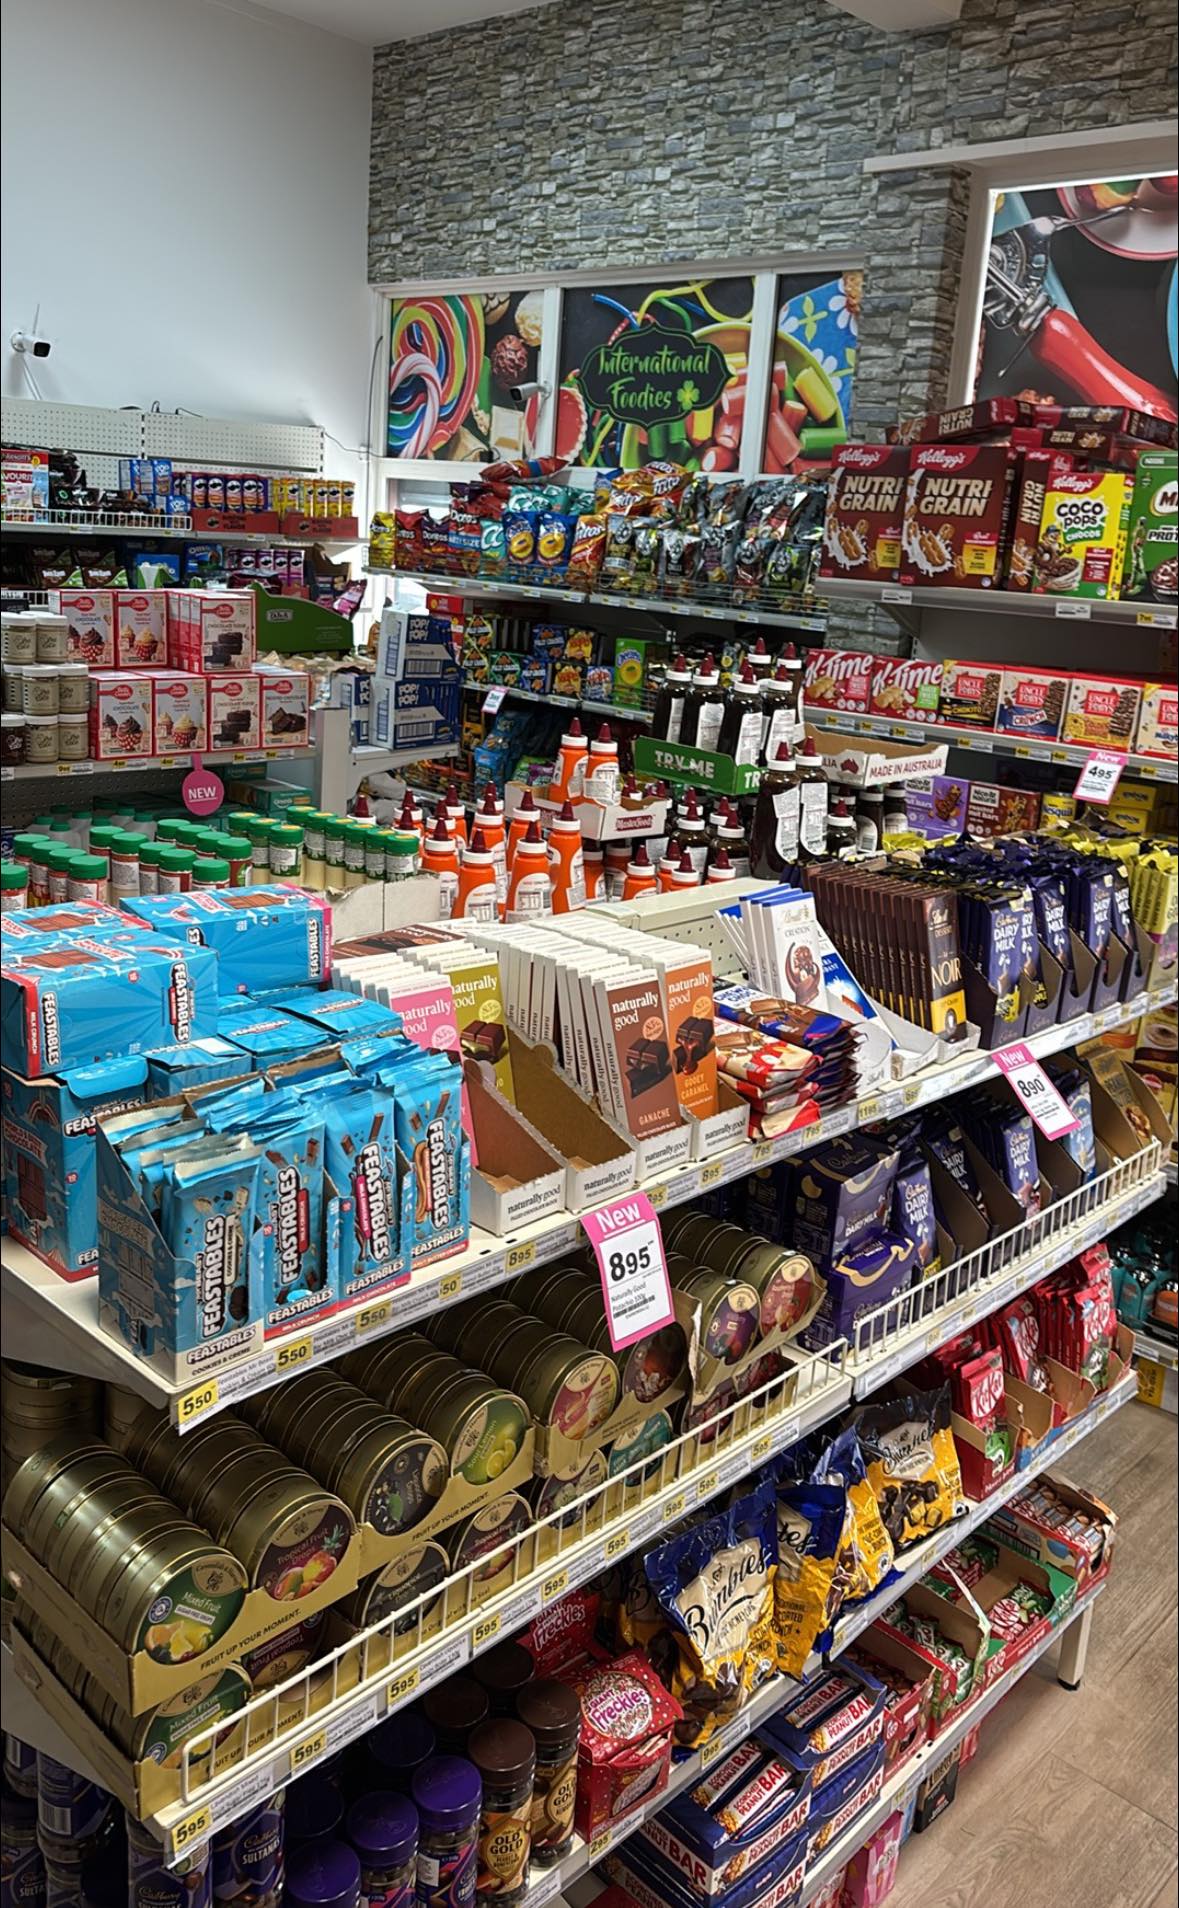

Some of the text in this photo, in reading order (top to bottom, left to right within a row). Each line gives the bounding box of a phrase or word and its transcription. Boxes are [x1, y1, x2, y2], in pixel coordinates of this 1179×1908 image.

[599, 345, 711, 375] International
[606, 377, 671, 411] Foodies
[839, 448, 880, 466] Kellogg's
[917, 449, 965, 468] Kellogg's
[1053, 475, 1094, 492] Kellogg's
[840, 494, 900, 512] GRAIN
[920, 497, 987, 516] GRAIN
[1057, 501, 1104, 517] COCO
[1064, 515, 1097, 529] pops
[806, 651, 873, 688] K-Time
[873, 659, 944, 696] K-Time
[958, 678, 981, 689] UNCLE
[1019, 686, 1044, 697] UNCLE
[1089, 693, 1117, 705] UNCLE
[1162, 703, 1178, 714] UNC
[689, 758, 715, 778] ME
[870, 758, 942, 778] MADE IN AUSTRALIA
[1097, 753, 1121, 762] New
[188, 787, 216, 799] NEW
[1045, 905, 1065, 921] DAIRY
[994, 923, 1019, 940] DAIRY
[996, 938, 1015, 952] MILK
[668, 972, 710, 995] naturally
[931, 958, 962, 990] NOIR
[170, 964, 189, 1041] FEASTABLES
[612, 992, 659, 1016] naturally
[42, 993, 59, 1065] FEASTABLES
[614, 1012, 639, 1032] good
[577, 1029, 589, 1079] naturally
[592, 1037, 605, 1082] naturally
[1000, 1050, 1025, 1066] New
[607, 1042, 619, 1090] naturally
[681, 1085, 709, 1101] CARAMEL
[1017, 1078, 1045, 1098] 890
[638, 1107, 671, 1126] GANACHE
[704, 1120, 746, 1140] naturally good
[645, 1139, 689, 1163] naturally good
[1010, 1140, 1030, 1161] DAIRY
[1013, 1154, 1030, 1169] MILK
[429, 1121, 448, 1228] FEASTABLES
[584, 1165, 633, 1191] naturally good
[702, 1167, 721, 1182] 895
[364, 1145, 389, 1259] FEASTABLES
[508, 1184, 561, 1215] naturally good
[904, 1190, 929, 1214] DAIRY
[279, 1167, 298, 1283] FEASTABLES
[595, 1202, 640, 1232] New
[909, 1209, 929, 1225] MILK
[508, 1248, 532, 1267] 895
[609, 1246, 650, 1282] 895
[203, 1216, 224, 1337] FEASTABLES
[346, 1260, 404, 1295] FEASTABLES
[268, 1290, 334, 1324] FEASTABLES
[360, 1310, 386, 1328] 550
[186, 1326, 256, 1364] FEASTABLES
[278, 1346, 308, 1368] 550
[192, 1361, 220, 1376] COOKIES
[182, 1390, 212, 1416] 550
[412, 1525, 430, 1541] FRUIT
[430, 1520, 441, 1531] UP
[441, 1509, 460, 1525] YOUR
[607, 1538, 627, 1554] 595
[543, 1578, 565, 1595] 595
[474, 1621, 497, 1641] 595
[533, 1604, 585, 1651] Freckles
[200, 1609, 302, 1670] FRUIT UP YOUR MOMENT.
[390, 1676, 416, 1698] 595
[822, 1678, 846, 1700] BAR
[590, 1689, 615, 1709] GIANT
[827, 1720, 851, 1738] PEANUT
[857, 1721, 880, 1748] BAR
[294, 1739, 321, 1764] 595
[736, 1743, 760, 1765] BAR
[734, 1783, 759, 1809] SCORCHED
[738, 1762, 786, 1817] PEANUT BAR
[781, 1802, 808, 1834] BAR
[177, 1816, 205, 1843] 595
[495, 1832, 520, 1845] OLD
[490, 1839, 523, 1854] GOLD
[668, 1843, 707, 1885] BAR
[776, 1865, 803, 1901] BAR
